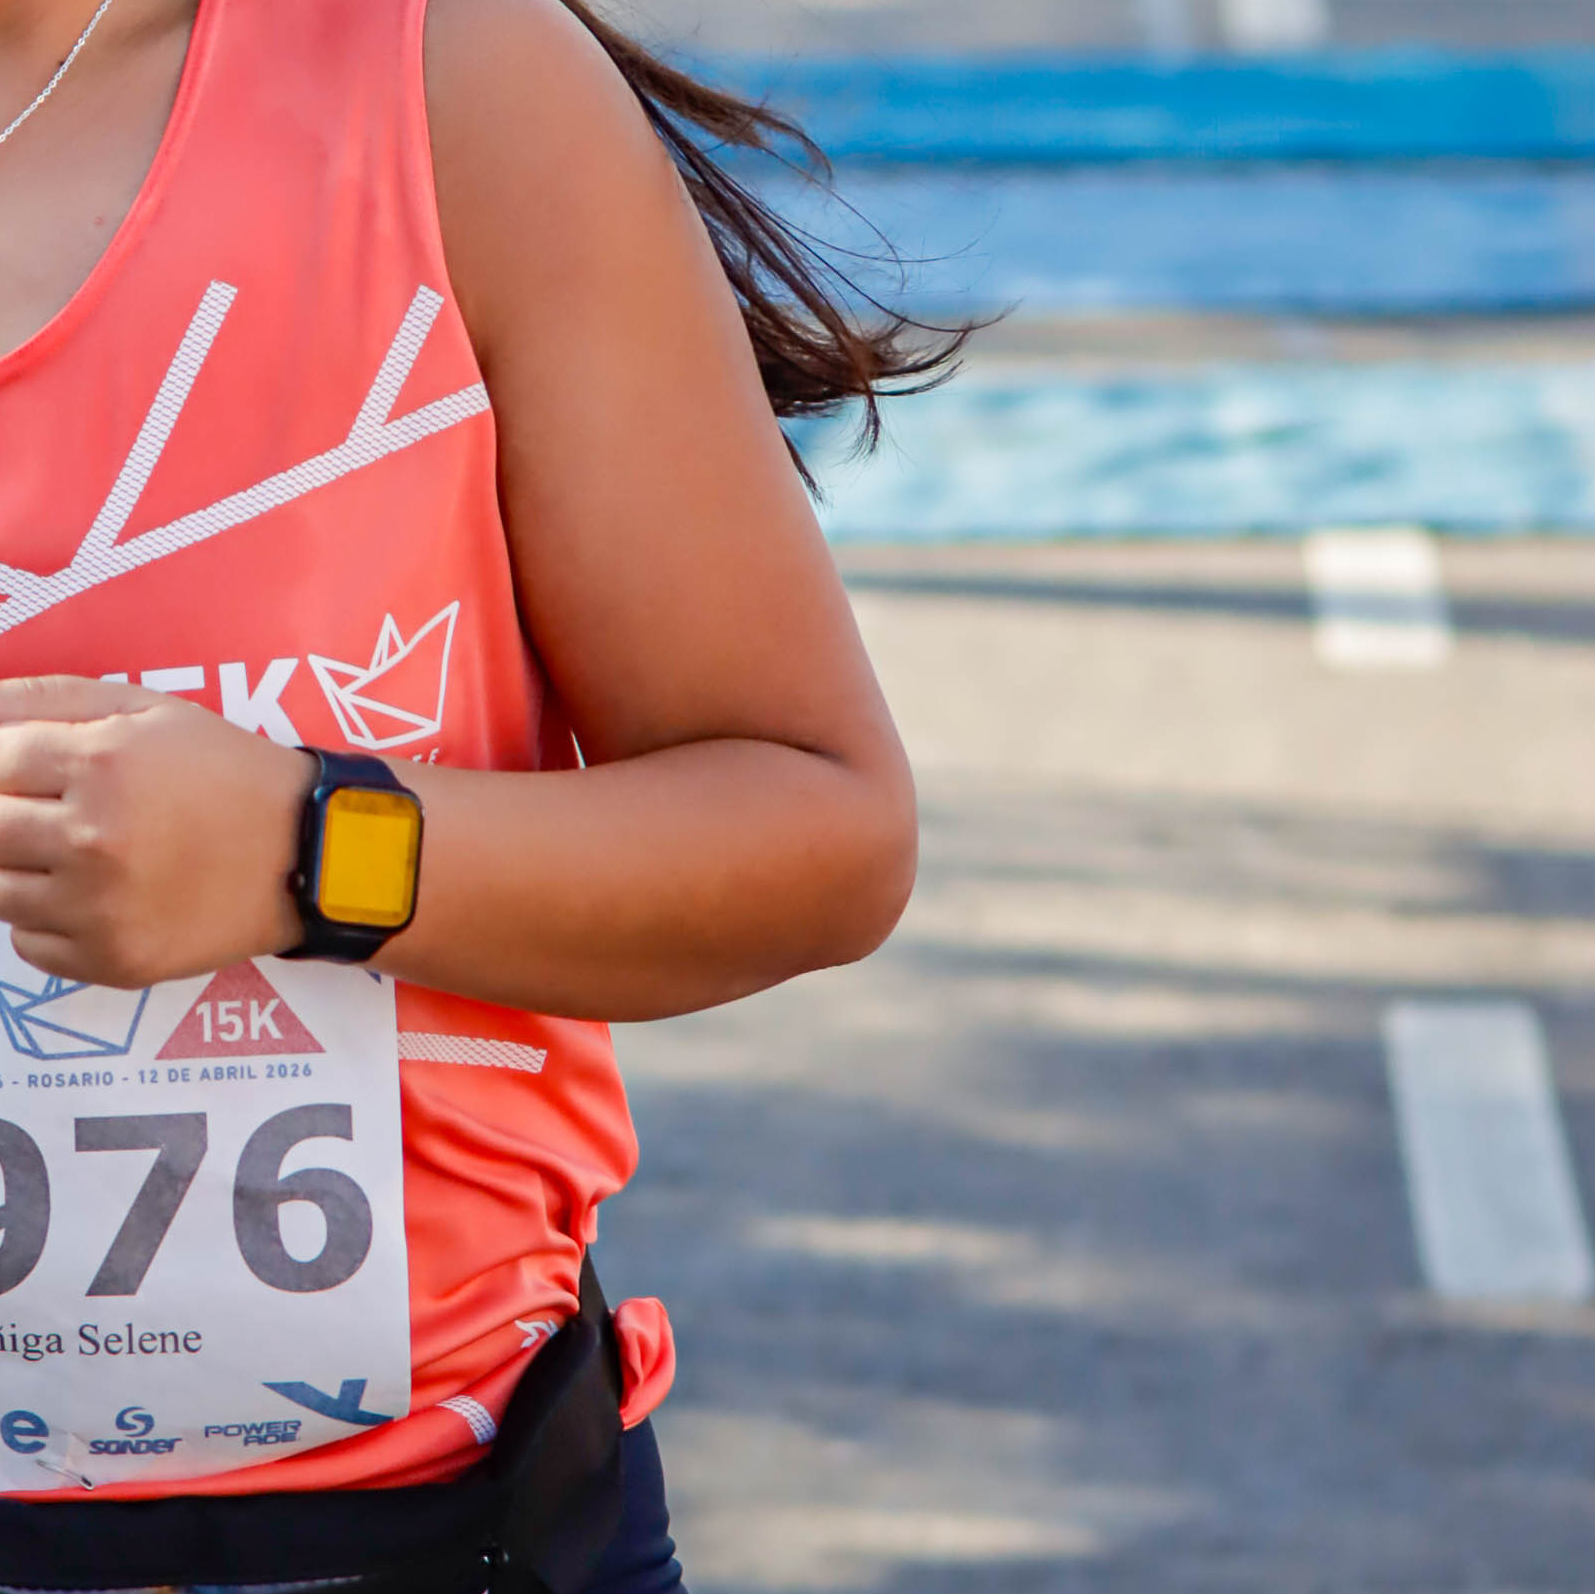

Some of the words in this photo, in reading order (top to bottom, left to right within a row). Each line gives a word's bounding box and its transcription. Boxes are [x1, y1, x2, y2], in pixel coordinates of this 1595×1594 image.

[197, 998, 283, 1044] 15K
[27, 1071, 114, 1088] ROSARIO
[138, 1068, 158, 1084] 12
[168, 1068, 191, 1082] DE
[200, 1064, 256, 1081] ABRIL
[266, 1062, 313, 1078] 2026
[78, 1323, 203, 1356] Selene
[205, 1420, 302, 1437] POWER
